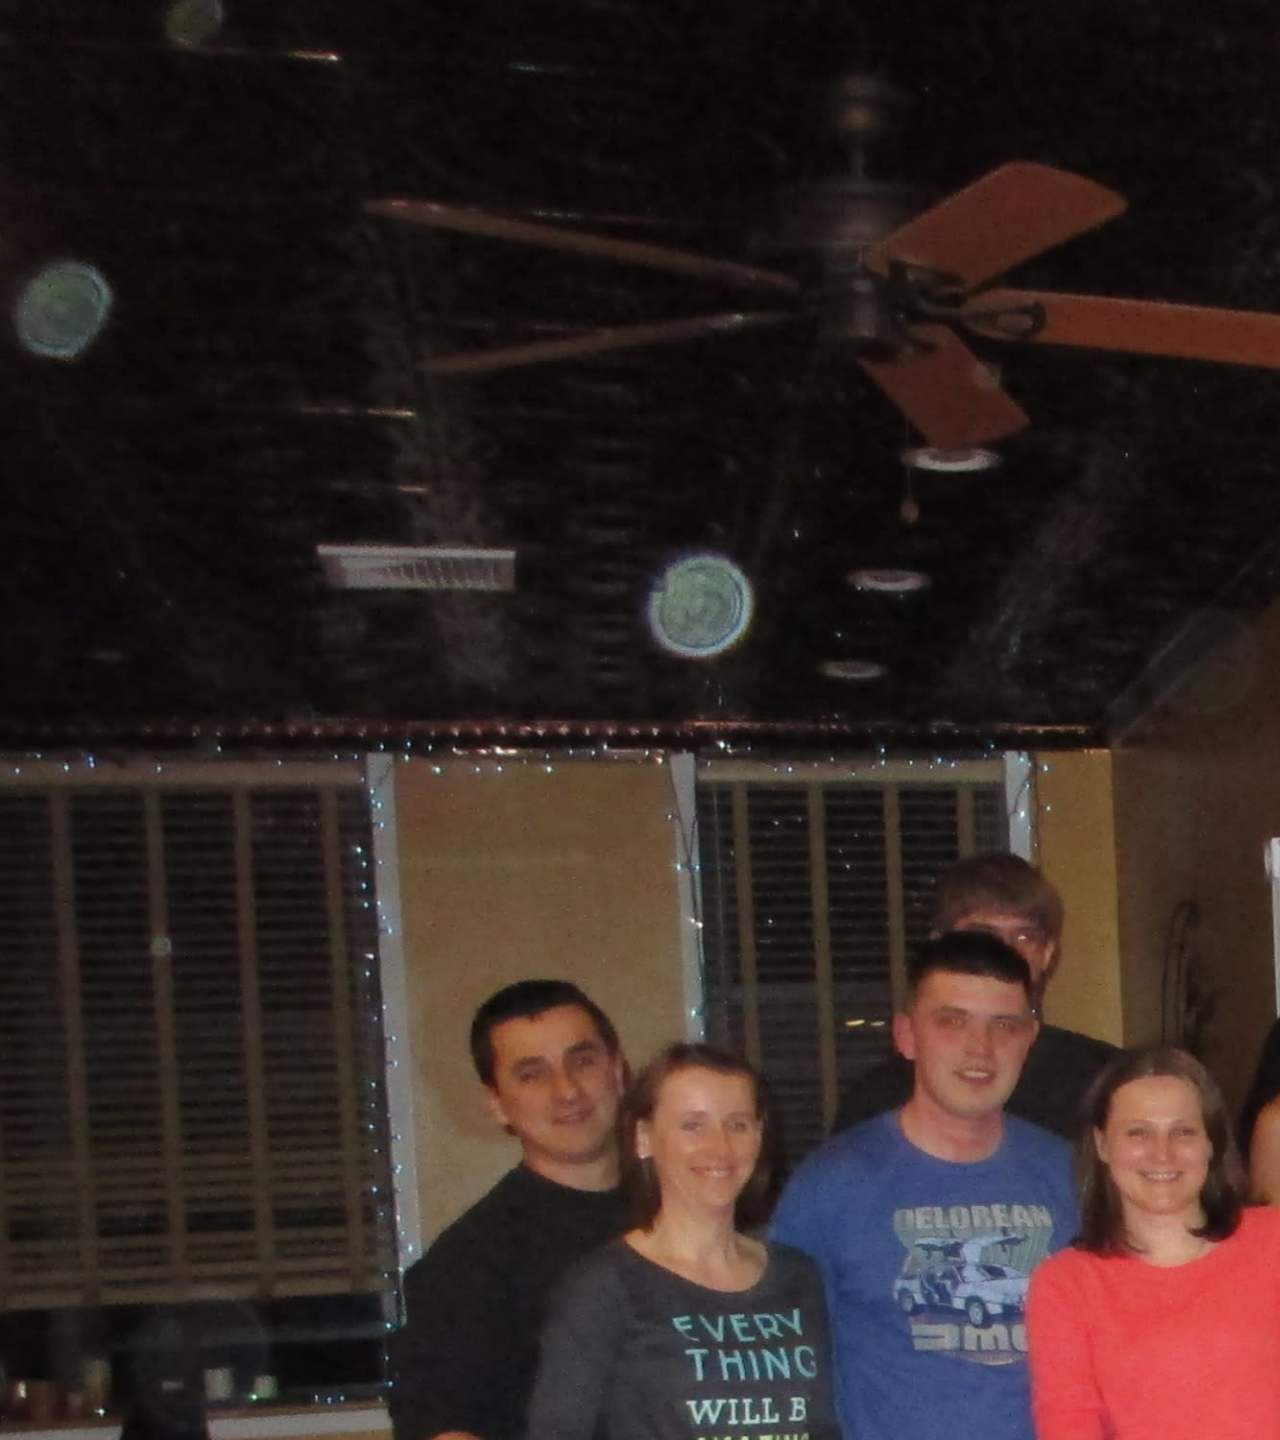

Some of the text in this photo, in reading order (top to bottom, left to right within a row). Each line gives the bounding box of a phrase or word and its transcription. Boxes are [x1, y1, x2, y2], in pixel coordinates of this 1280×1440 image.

[893, 1203, 1052, 1232] DELOREAN
[672, 1308, 803, 1342] EVERY
[685, 1346, 817, 1381] THING
[686, 1396, 807, 1425] WILL B
